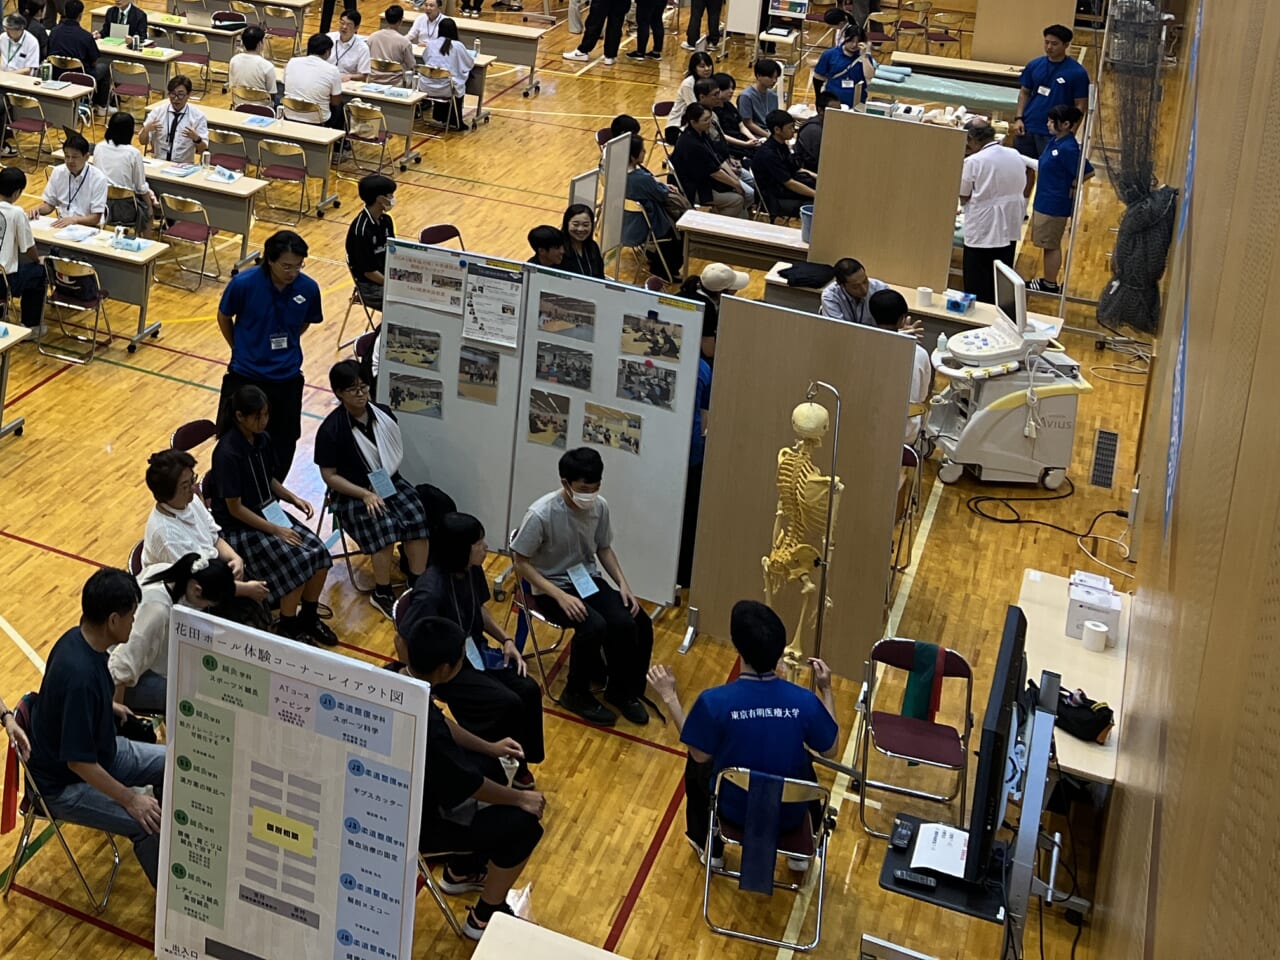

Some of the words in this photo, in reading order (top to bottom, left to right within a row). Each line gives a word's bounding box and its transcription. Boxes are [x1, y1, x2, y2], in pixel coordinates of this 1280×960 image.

[175, 621, 404, 705] 花田ホール体験コーナーレイアウト図
[274, 696, 311, 713] テーピング
[730, 707, 800, 720] 東京有明医療大学
[333, 715, 379, 735] スポーツ科学
[172, 943, 198, 959] 出入口
